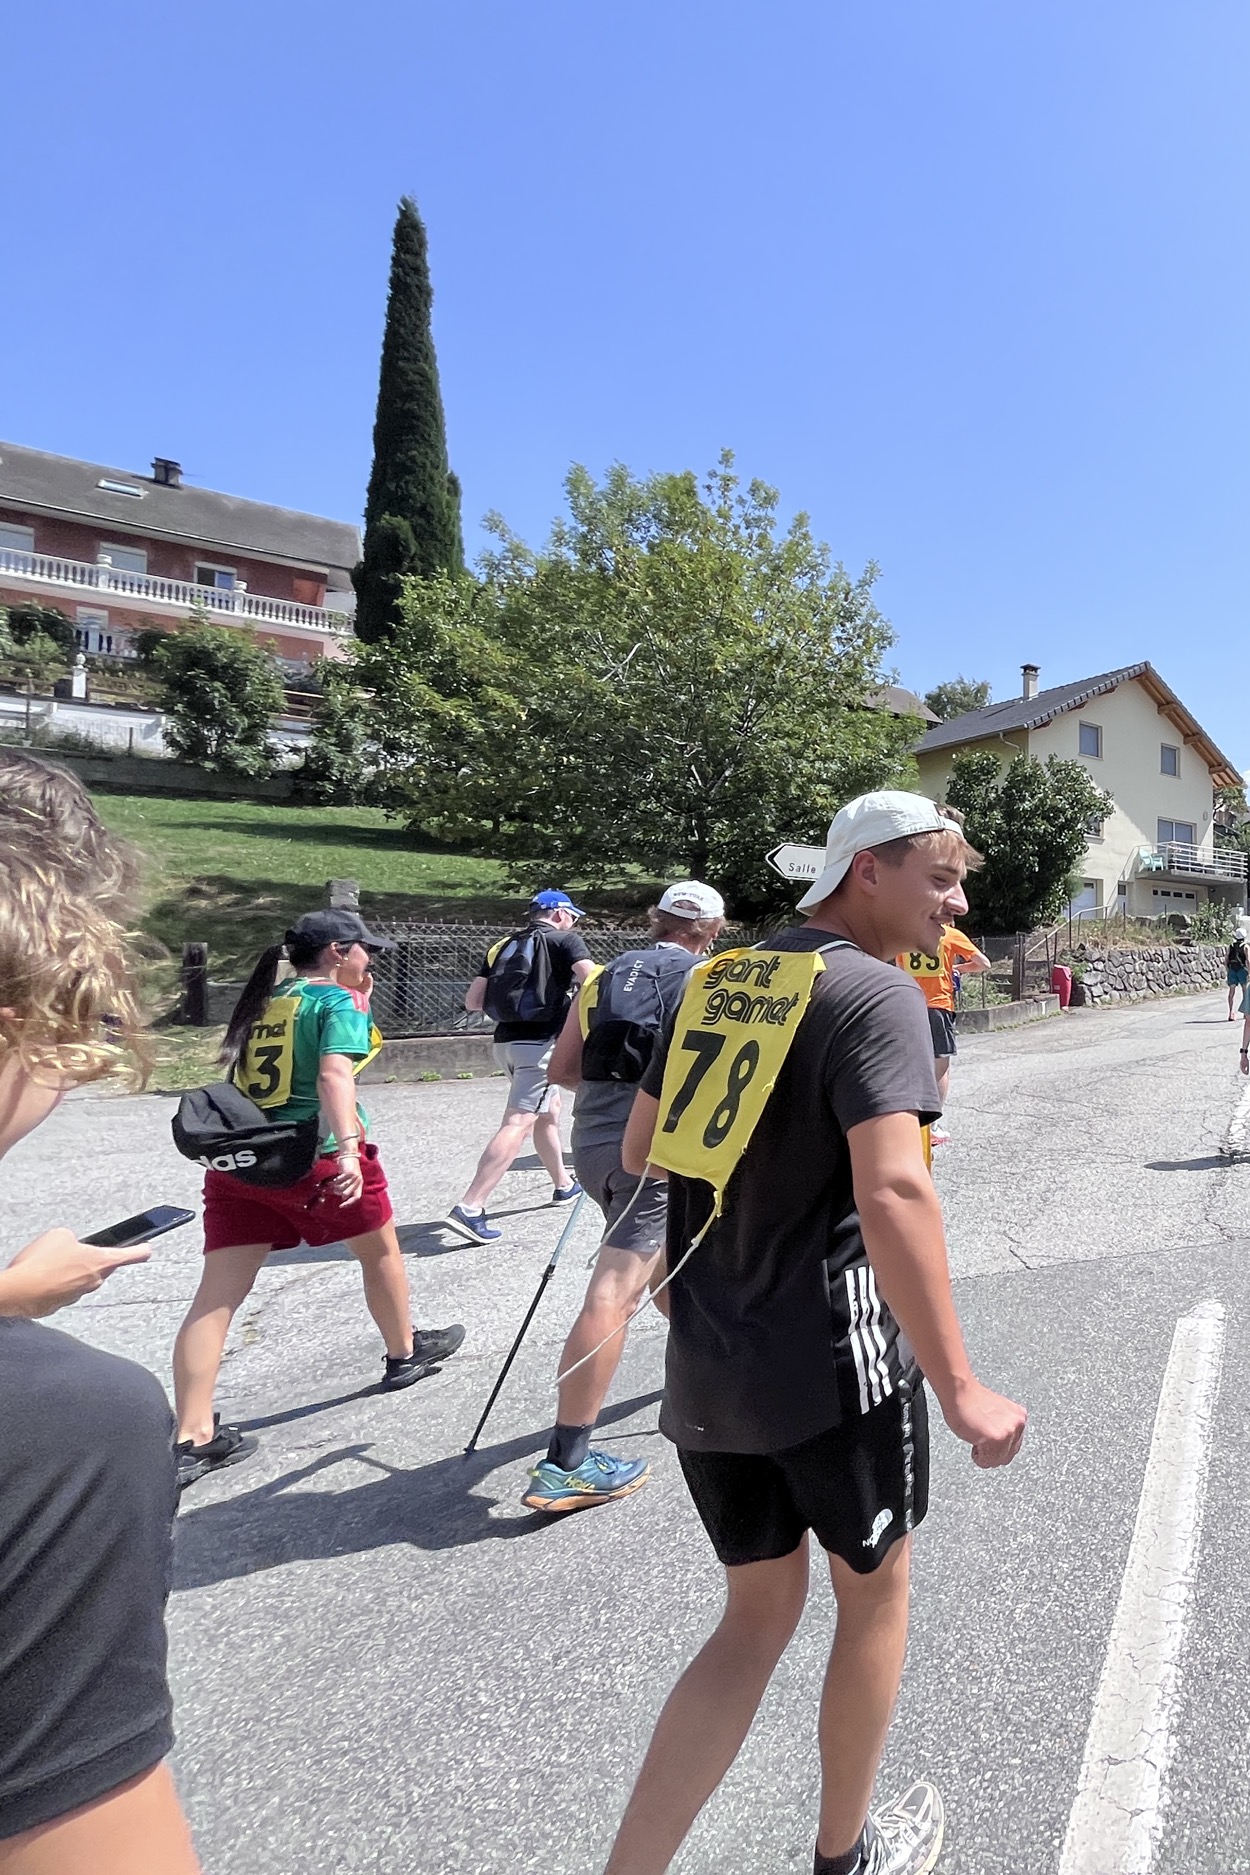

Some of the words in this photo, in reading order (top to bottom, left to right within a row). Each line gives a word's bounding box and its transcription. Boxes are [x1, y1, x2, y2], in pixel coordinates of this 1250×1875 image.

[788, 862, 816, 874] Salle
[623, 959, 645, 992] EVADICT
[702, 955, 781, 990] gant
[248, 1045, 284, 1099] 3
[661, 1029, 760, 1149] 78
